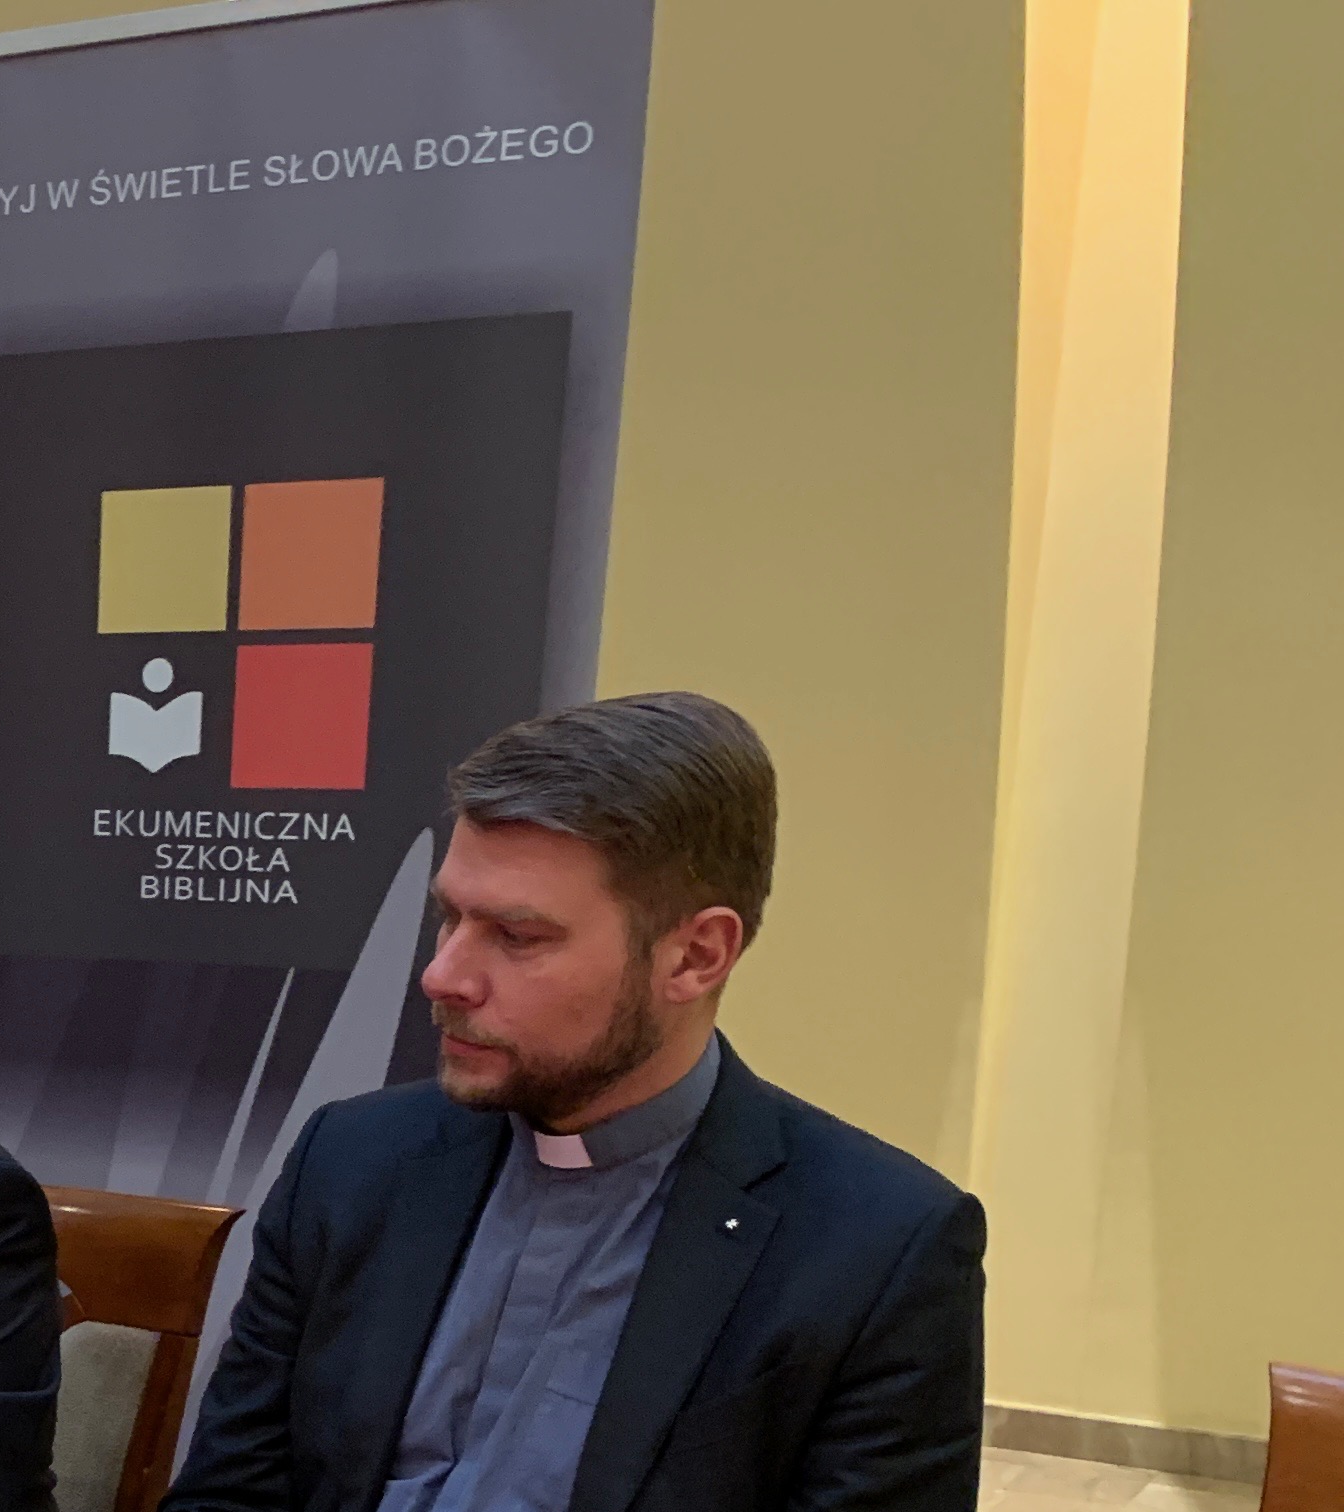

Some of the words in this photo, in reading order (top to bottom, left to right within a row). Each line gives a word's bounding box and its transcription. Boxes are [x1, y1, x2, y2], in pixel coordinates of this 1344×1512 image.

[47, 178, 80, 210] W
[89, 159, 252, 207] ŚWIETLE
[263, 142, 403, 187] SŁOWA
[413, 120, 594, 172] BOŻEGO
[93, 809, 356, 842] EKUMENICZNA
[155, 844, 290, 872] SZKOŁA
[140, 875, 298, 904] BIBLIJNA
